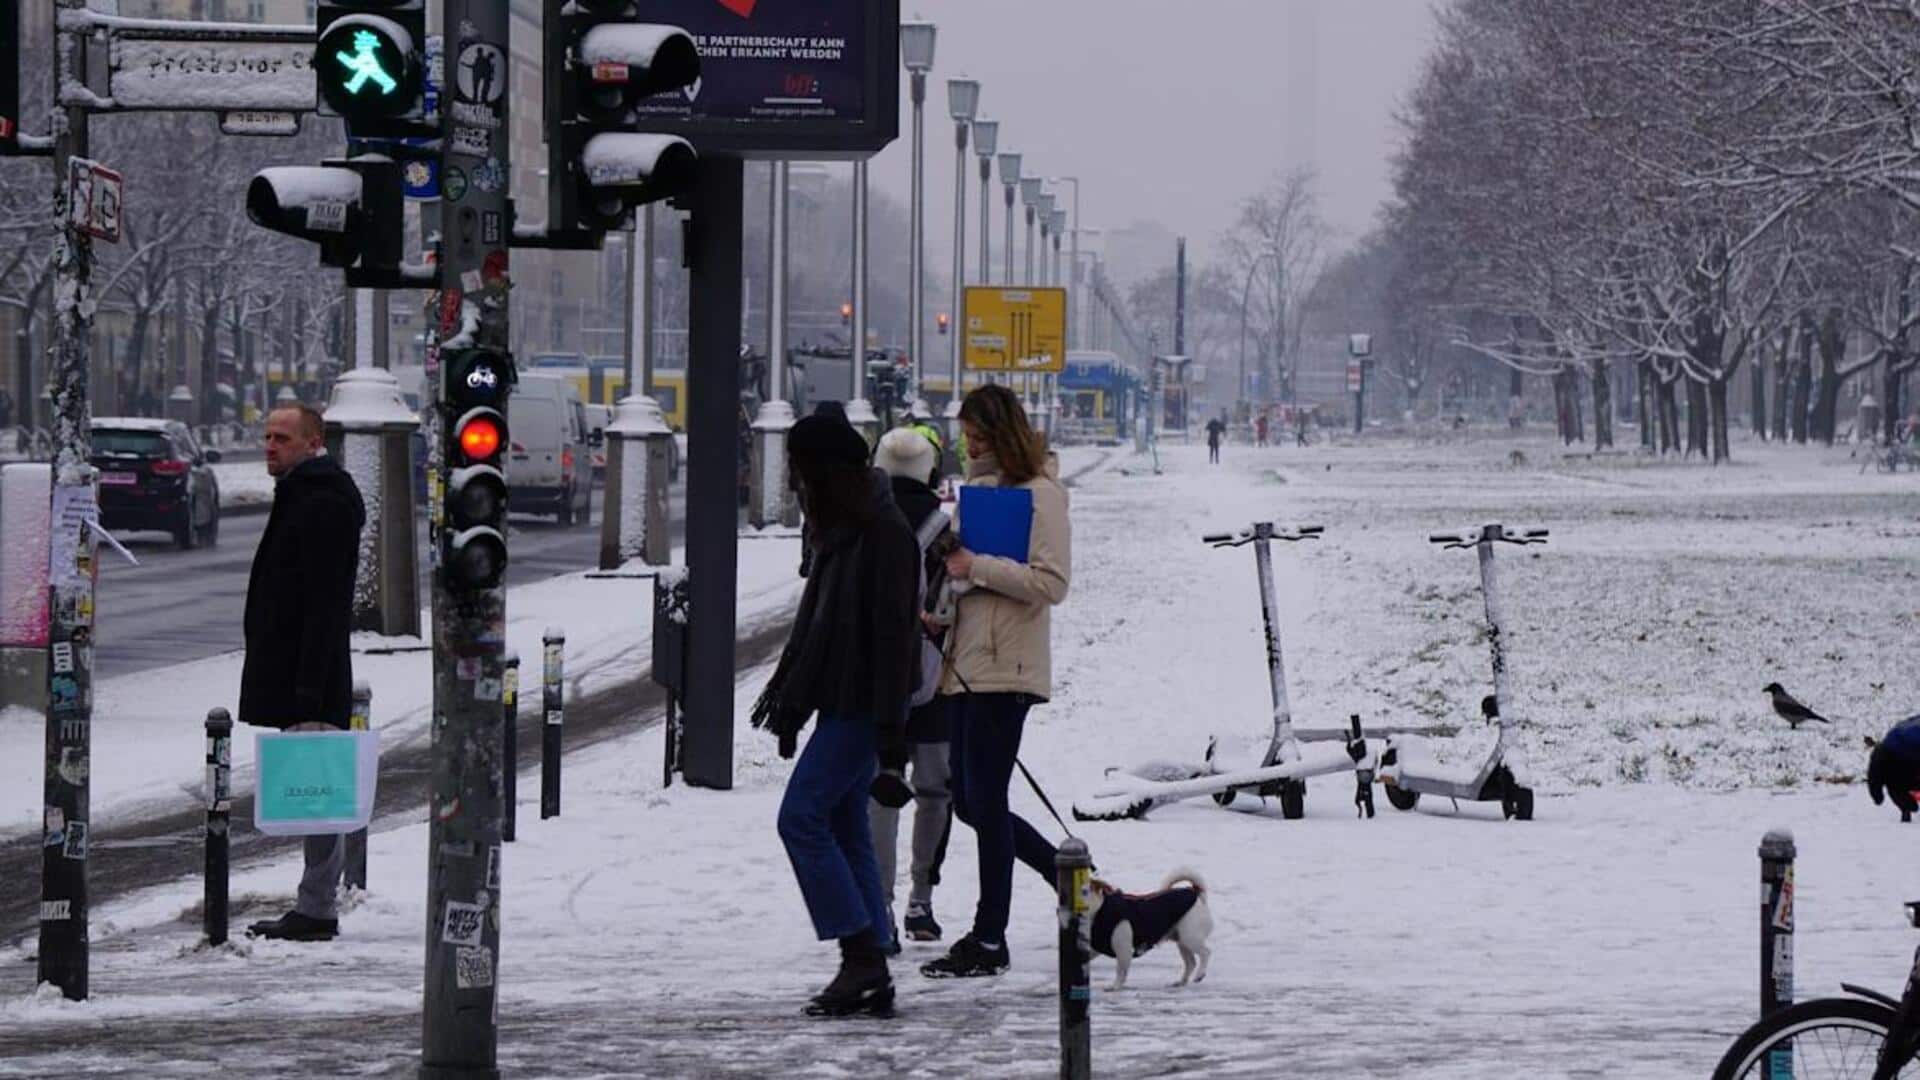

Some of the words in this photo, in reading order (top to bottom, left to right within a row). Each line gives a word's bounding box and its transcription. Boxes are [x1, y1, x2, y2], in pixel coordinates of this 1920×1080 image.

[710, 35, 807, 48] PARTNERSCHAFT
[810, 38, 845, 49] KANN
[697, 46, 727, 57] CHEN
[730, 47, 787, 58] ERKANNT
[790, 48, 842, 60] WERDEN
